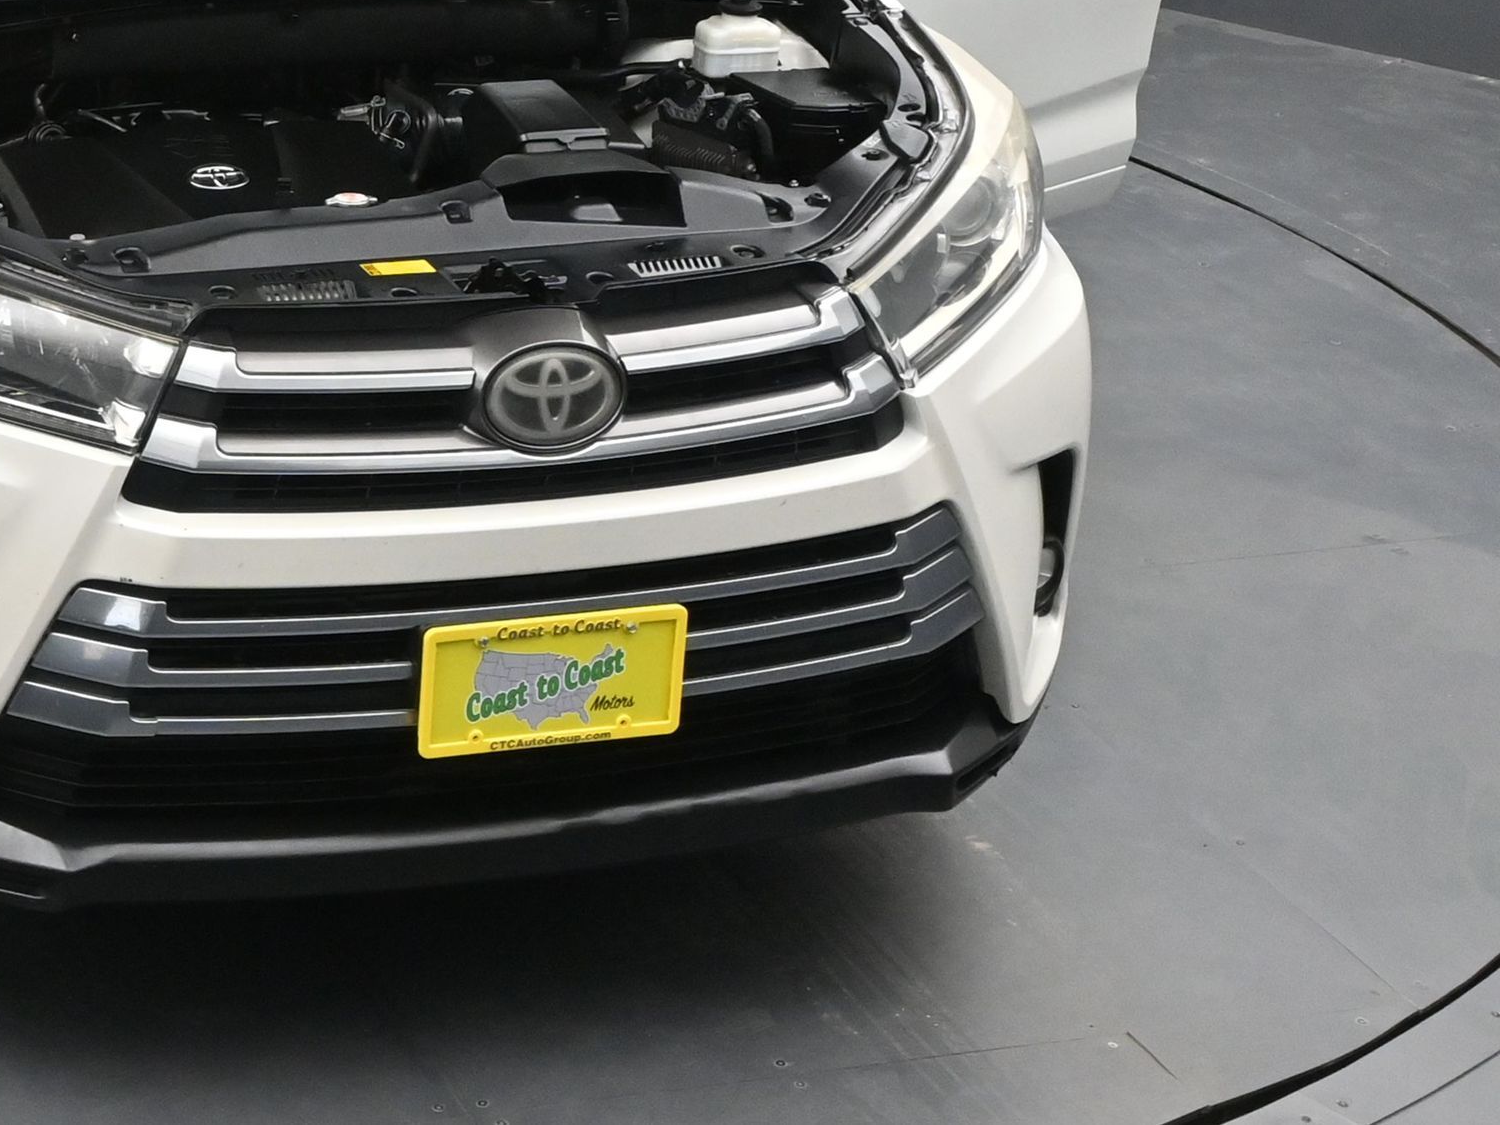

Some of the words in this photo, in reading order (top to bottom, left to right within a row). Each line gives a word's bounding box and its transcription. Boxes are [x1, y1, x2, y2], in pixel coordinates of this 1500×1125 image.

[496, 626, 545, 641] Coast
[552, 624, 571, 636] to
[574, 618, 621, 634] Coast
[466, 681, 528, 723] Coast
[536, 675, 560, 700] to
[565, 649, 625, 690] Coast
[590, 695, 635, 711] Motors
[490, 731, 612, 750] CTCAutoGroup.com
